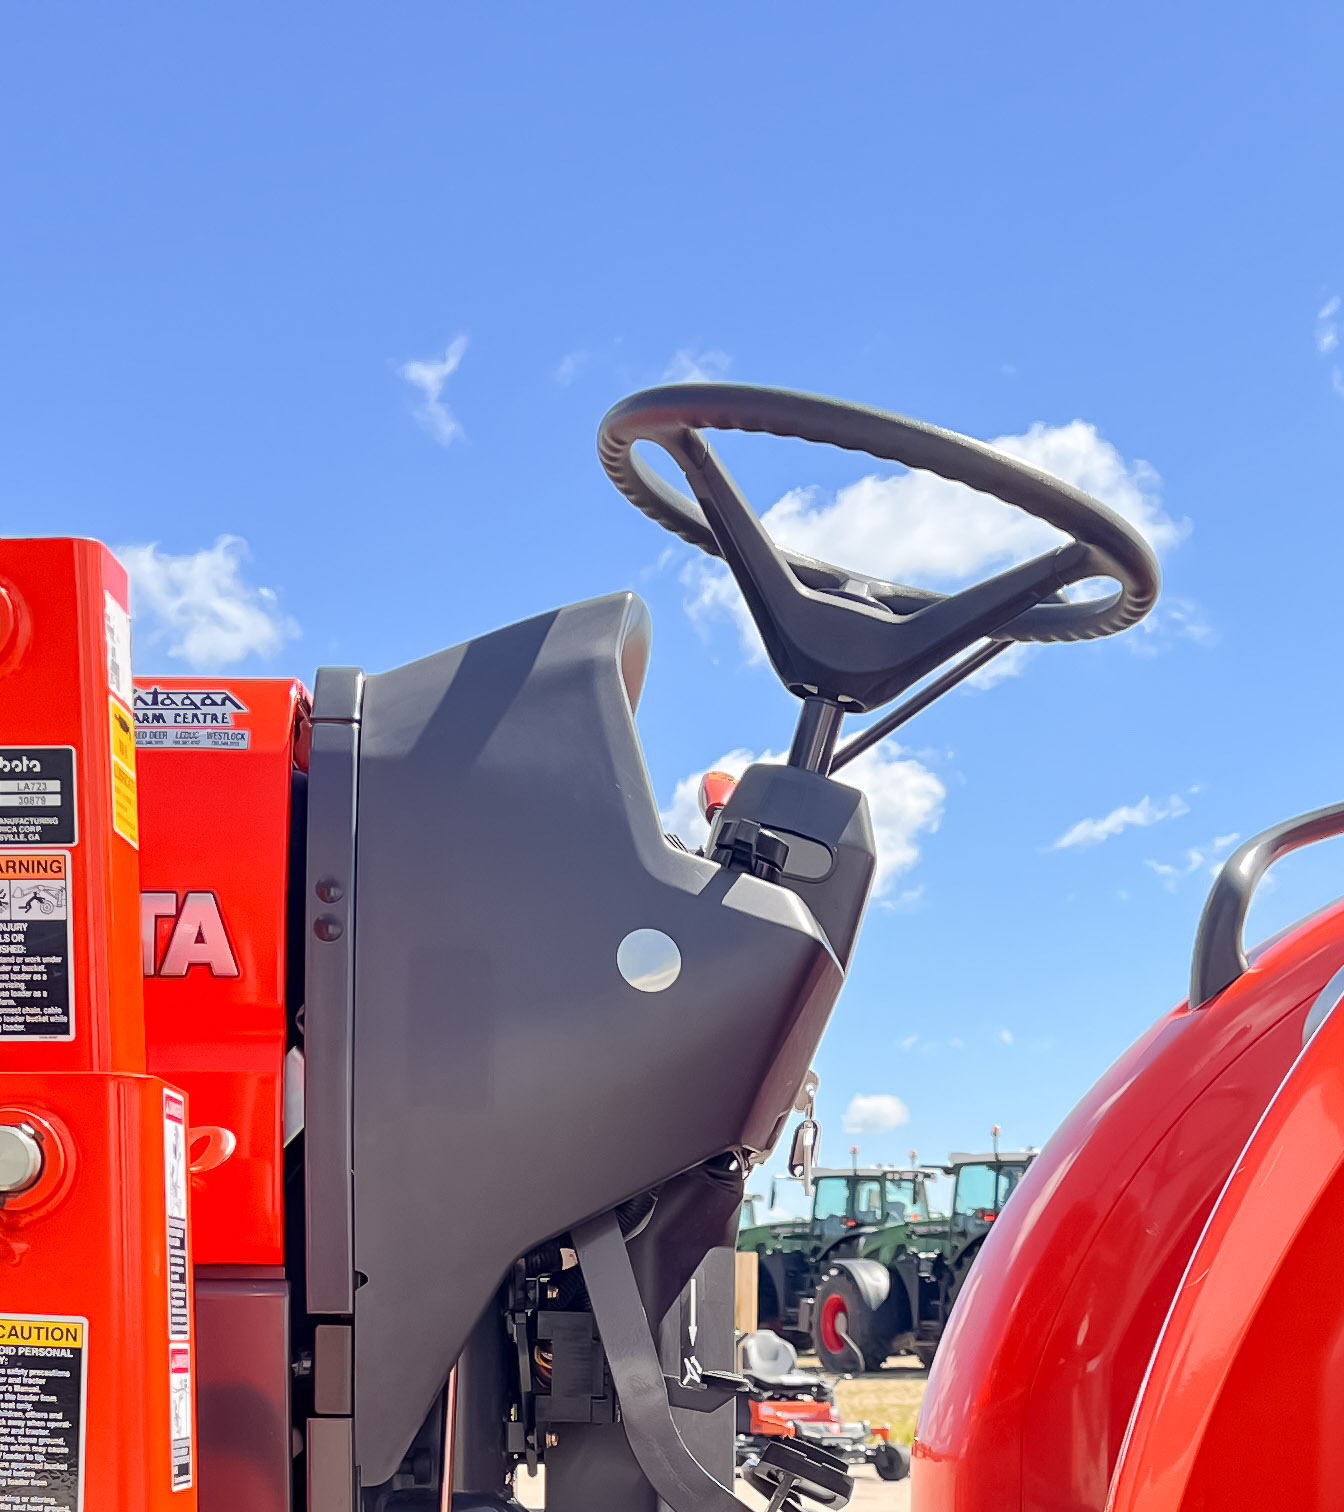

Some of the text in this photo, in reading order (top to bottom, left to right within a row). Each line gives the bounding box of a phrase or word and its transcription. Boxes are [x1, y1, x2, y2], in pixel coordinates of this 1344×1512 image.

[174, 713, 229, 724] CENTRE
[207, 732, 245, 741] WESTLOCK
[17, 782, 47, 791] LA723
[11, 934, 25, 942] OR
[18, 1347, 73, 1358] PERSONAL
